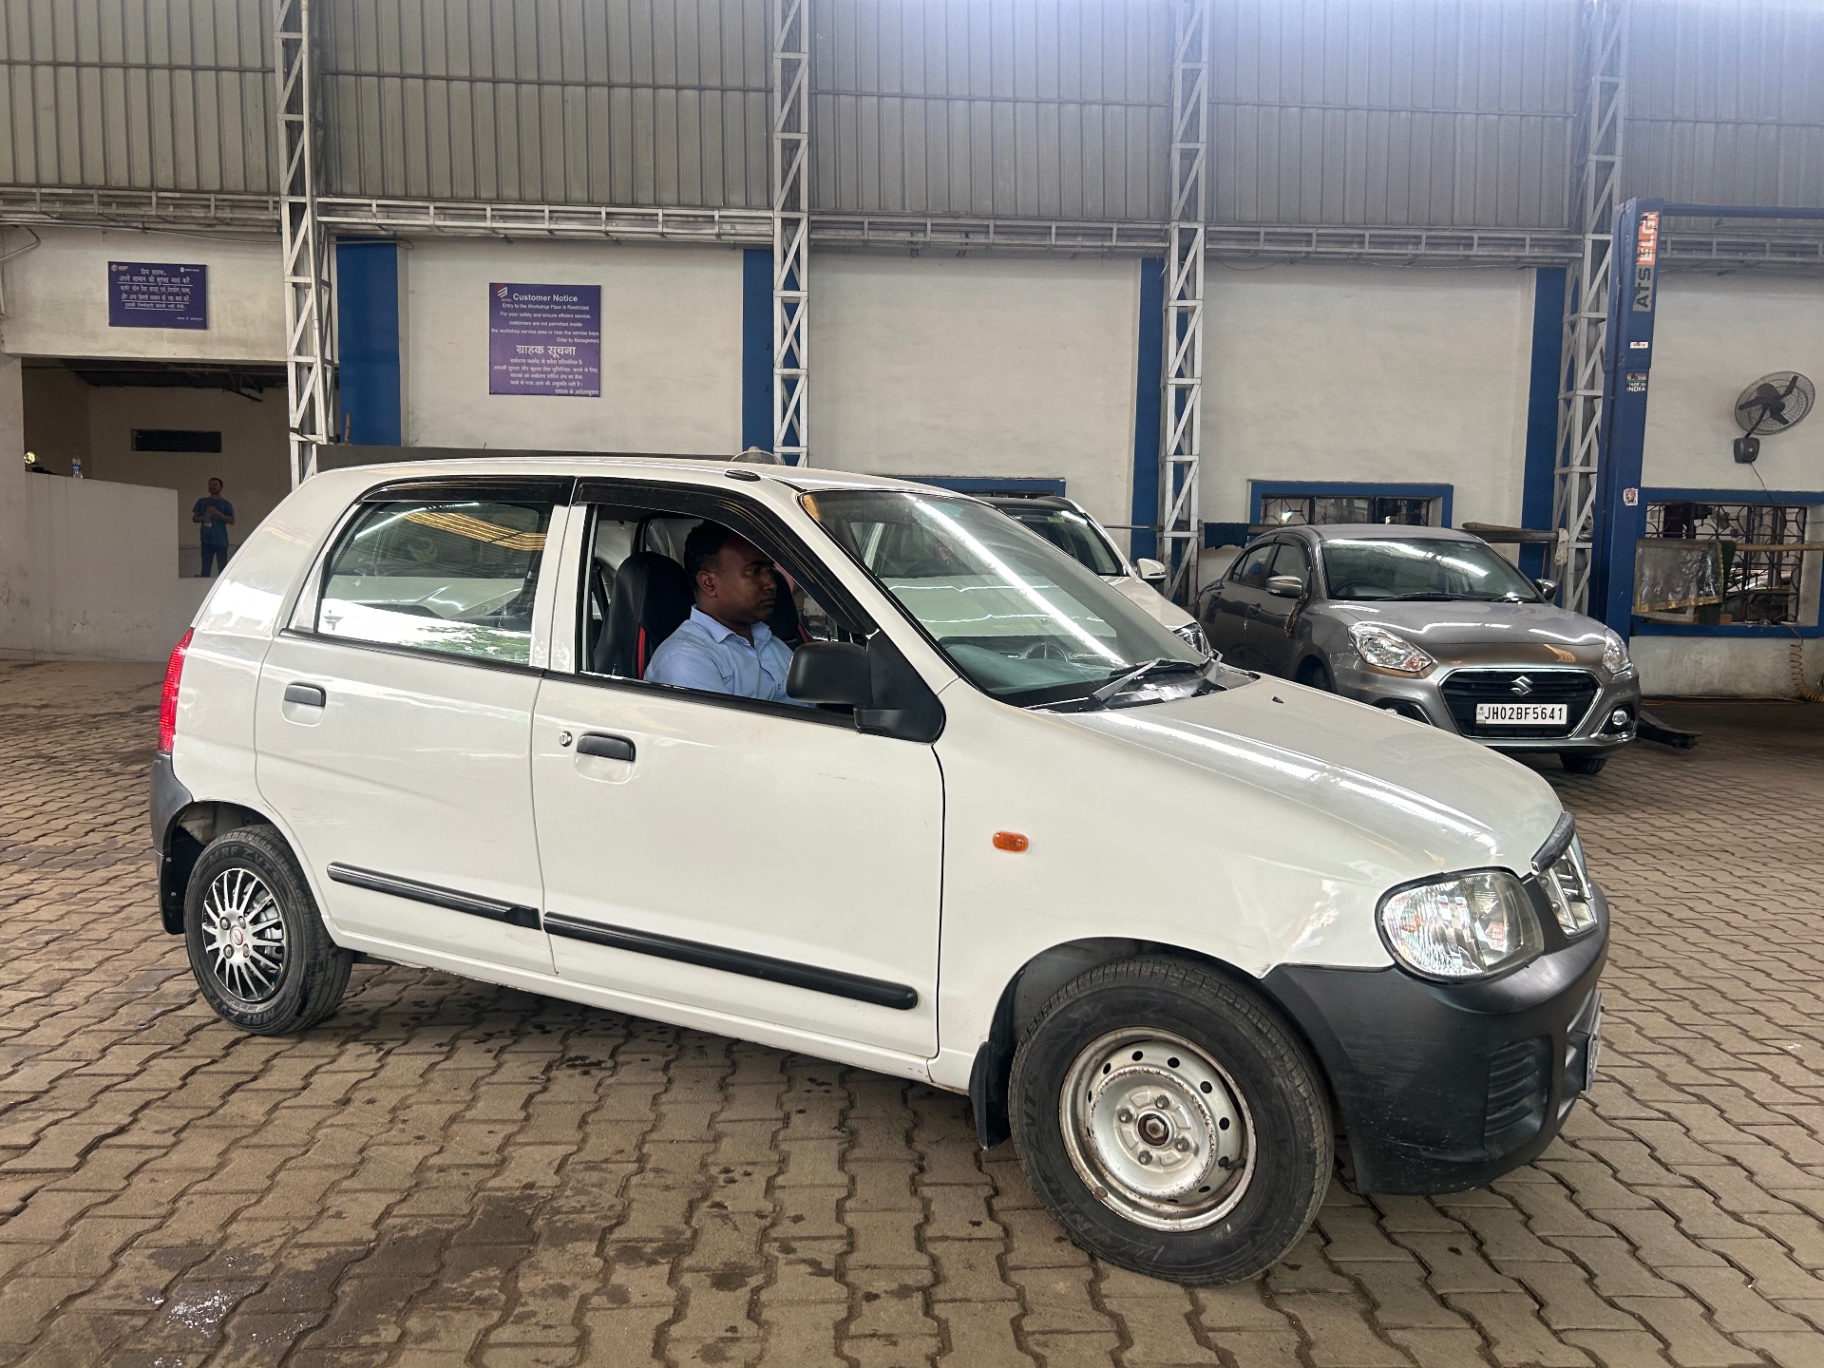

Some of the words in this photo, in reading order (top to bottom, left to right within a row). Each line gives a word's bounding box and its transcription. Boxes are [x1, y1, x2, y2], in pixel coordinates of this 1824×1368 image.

[1636, 267, 1651, 308] ATS
[513, 293, 550, 301] Customer
[516, 345, 544, 354] ग्राहक
[547, 346, 576, 358] सूचना
[1484, 706, 1563, 720] JH02BF5641
[208, 846, 239, 866] MRF
